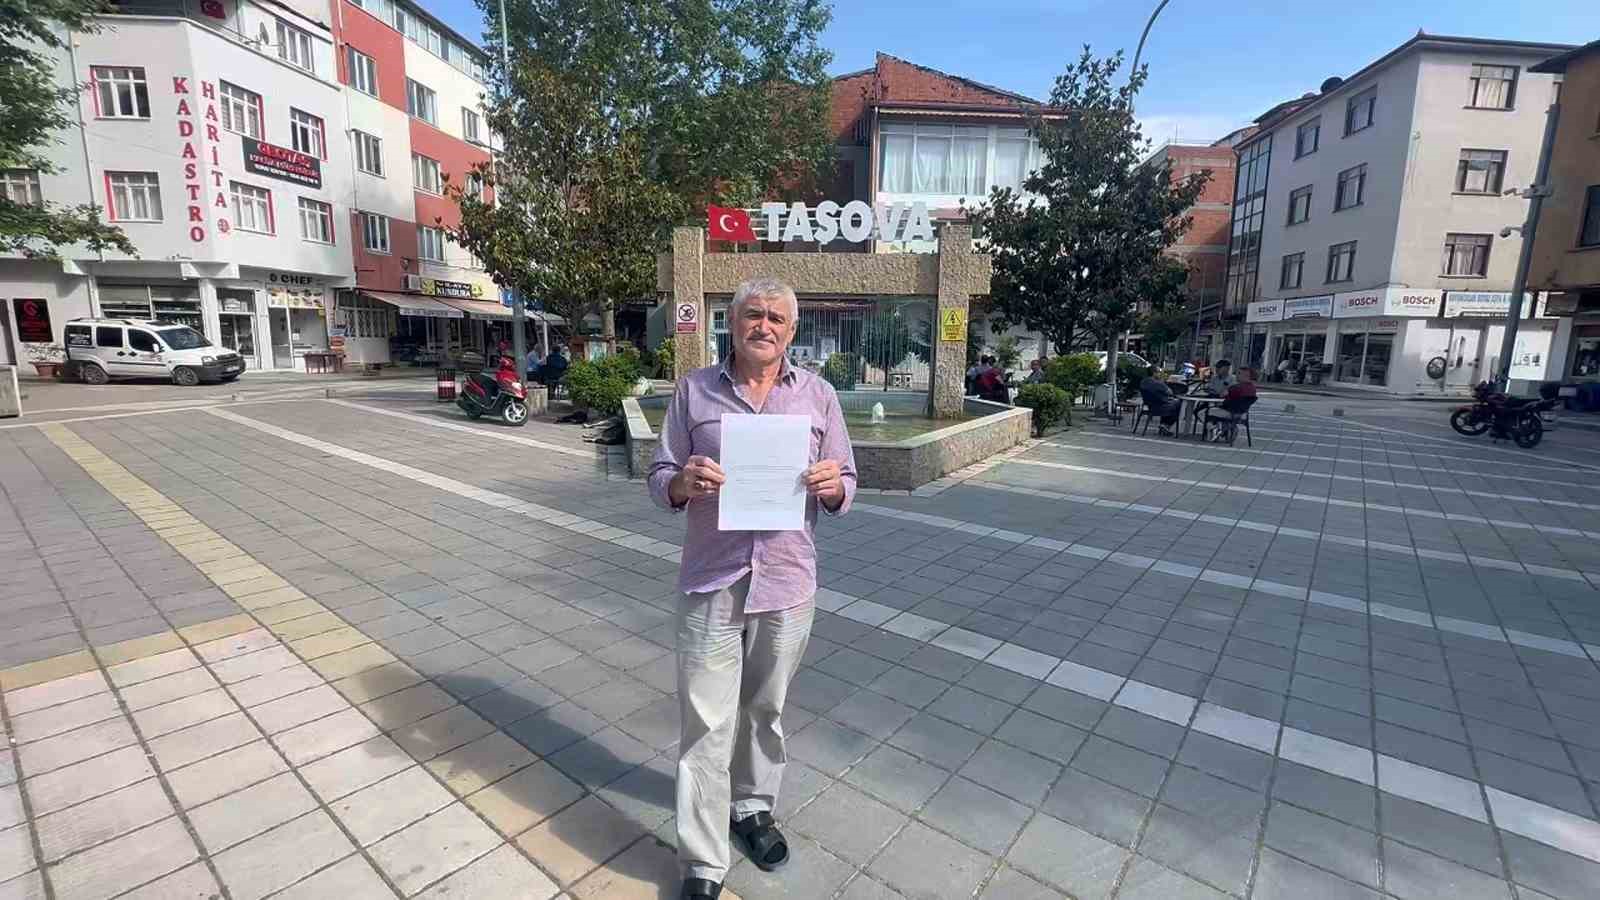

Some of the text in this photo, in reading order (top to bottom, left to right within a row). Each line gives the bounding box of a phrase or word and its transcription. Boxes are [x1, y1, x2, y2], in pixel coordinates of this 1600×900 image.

[200, 79, 228, 209] HARİTA
[172, 76, 205, 243] KADASTRO
[761, 199, 937, 246] TAŞOVA
[281, 273, 313, 285] CHEF
[1348, 296, 1379, 307] BOSCH
[1402, 294, 1436, 306] BOSCH
